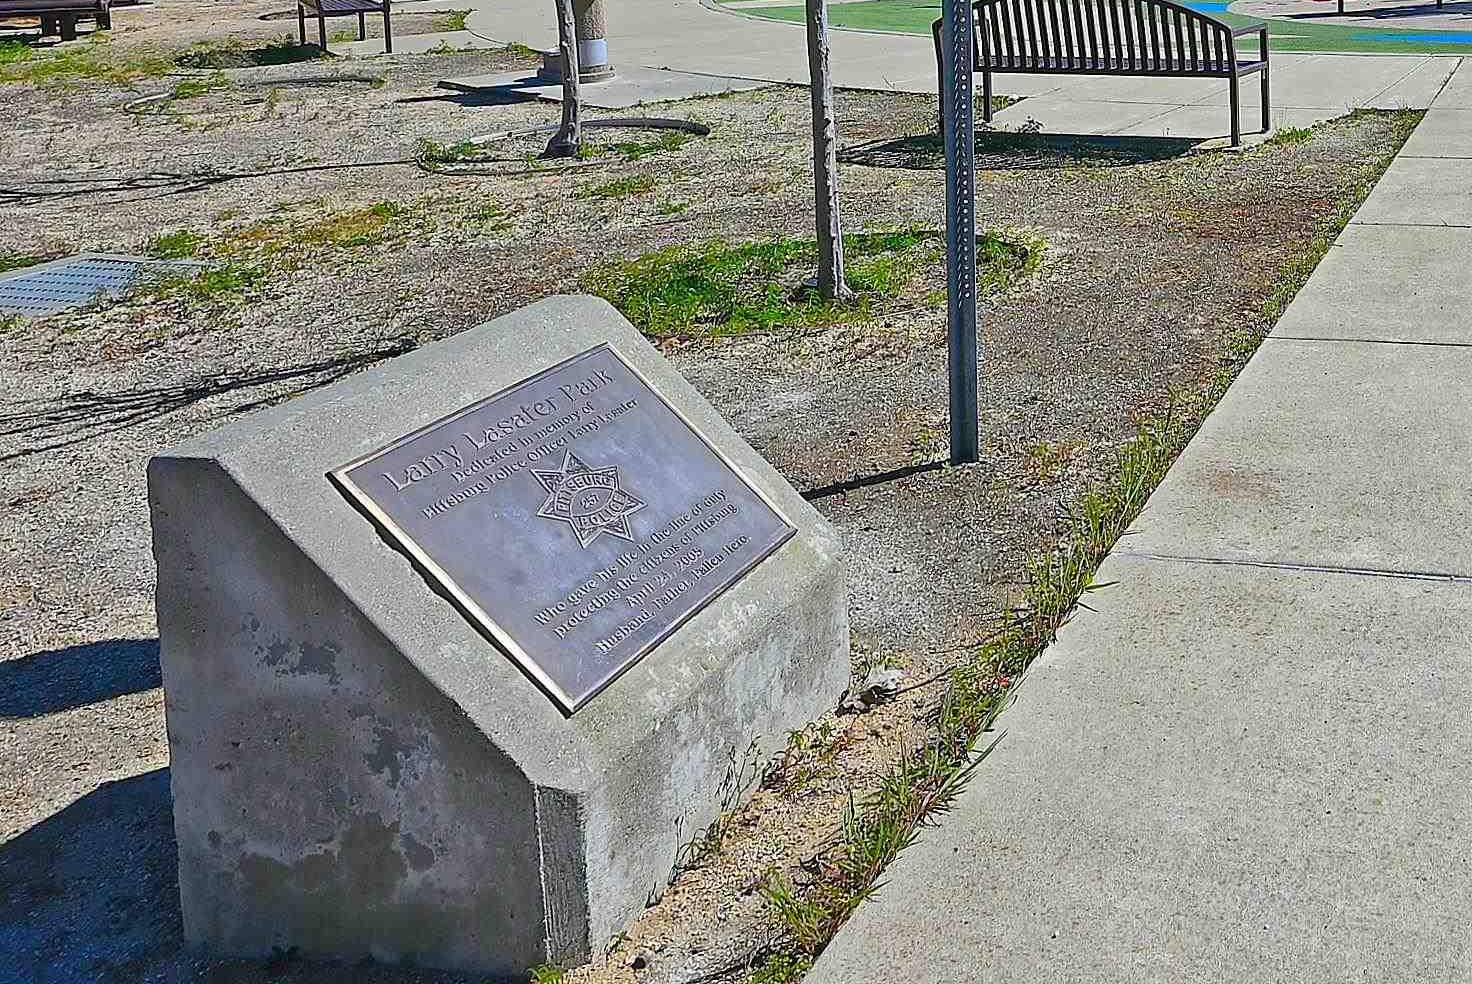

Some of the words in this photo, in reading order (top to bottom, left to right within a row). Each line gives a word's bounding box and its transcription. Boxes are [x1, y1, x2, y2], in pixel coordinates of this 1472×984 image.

[383, 445, 464, 493] Larry
[463, 396, 558, 451] Lasater
[558, 368, 614, 402] Park
[422, 481, 489, 519] Pittsburg
[484, 460, 528, 485] Police
[526, 436, 569, 462] Officer
[567, 419, 600, 439] Larry
[597, 398, 639, 424] Lasater
[451, 442, 518, 483] Dedicated
[535, 410, 580, 438] memory
[580, 400, 595, 415] of
[579, 490, 626, 527] POLICE
[533, 601, 567, 626] Who
[567, 578, 599, 606] gave
[596, 564, 619, 582] his
[615, 551, 639, 569] life
[650, 528, 672, 546] the
[552, 588, 622, 641] protecting
[616, 572, 639, 592] the
[639, 543, 682, 576] citizens
[690, 503, 738, 537] Pittsburg
[624, 579, 658, 609] April
[690, 555, 724, 580] Fallen
